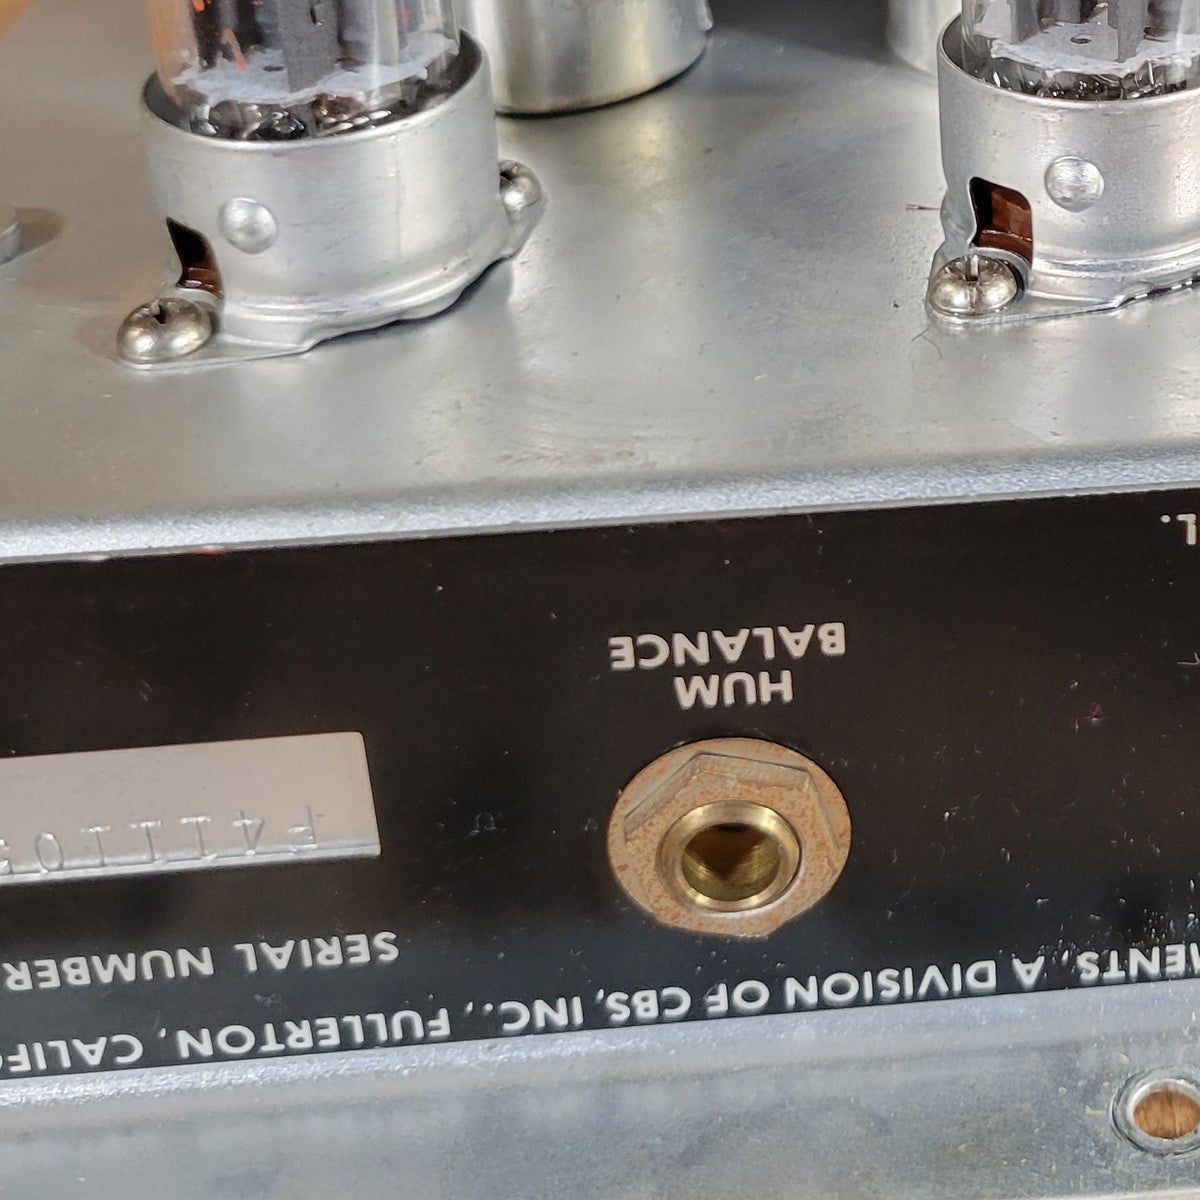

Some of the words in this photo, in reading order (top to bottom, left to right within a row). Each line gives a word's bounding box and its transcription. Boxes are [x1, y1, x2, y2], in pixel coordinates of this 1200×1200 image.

[609, 622, 846, 669] BALANCE
[674, 670, 793, 708] HUM
[2, 946, 214, 992] NUMBER
[234, 931, 399, 972] SERIAL
[1012, 955, 1045, 988] A
[596, 986, 692, 1023] CBS,
[704, 980, 770, 1014] OF
[784, 960, 997, 1009] DIVISION
[159, 1007, 451, 1059] FULLERTON,
[0, 1034, 144, 1073] CALIF
